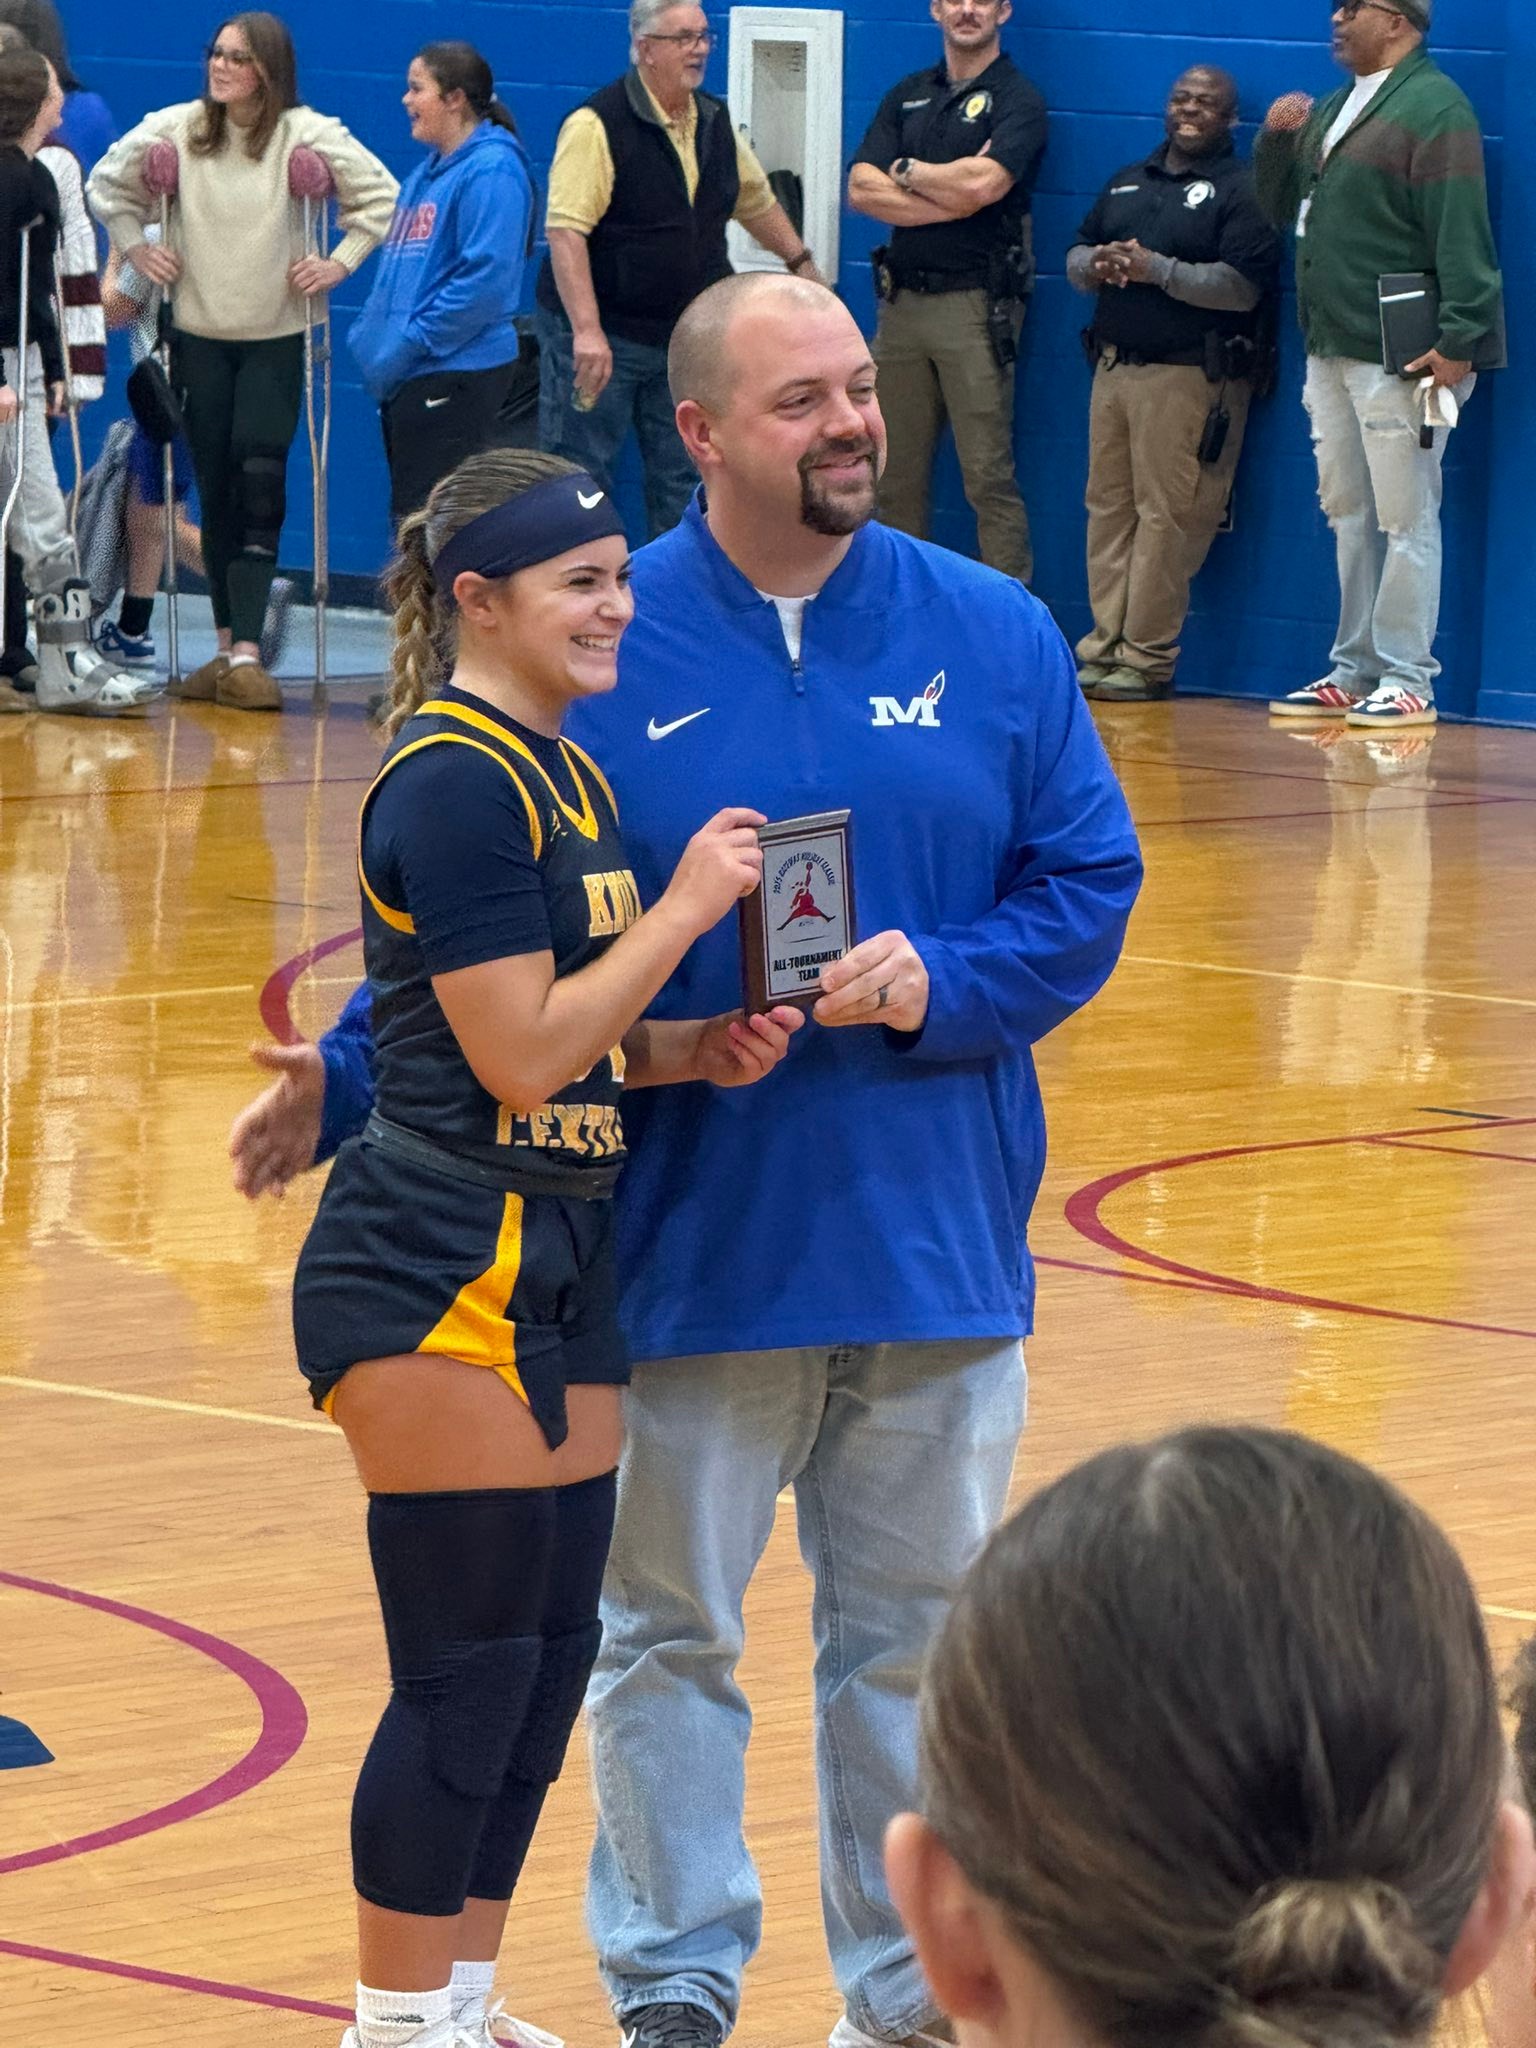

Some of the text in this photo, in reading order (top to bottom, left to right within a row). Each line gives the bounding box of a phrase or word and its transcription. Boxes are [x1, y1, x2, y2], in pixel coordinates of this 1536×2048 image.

[869, 697, 941, 727] M
[773, 949, 843, 972] ALL-TOURNAMENT
[798, 967, 820, 982] TEAM
